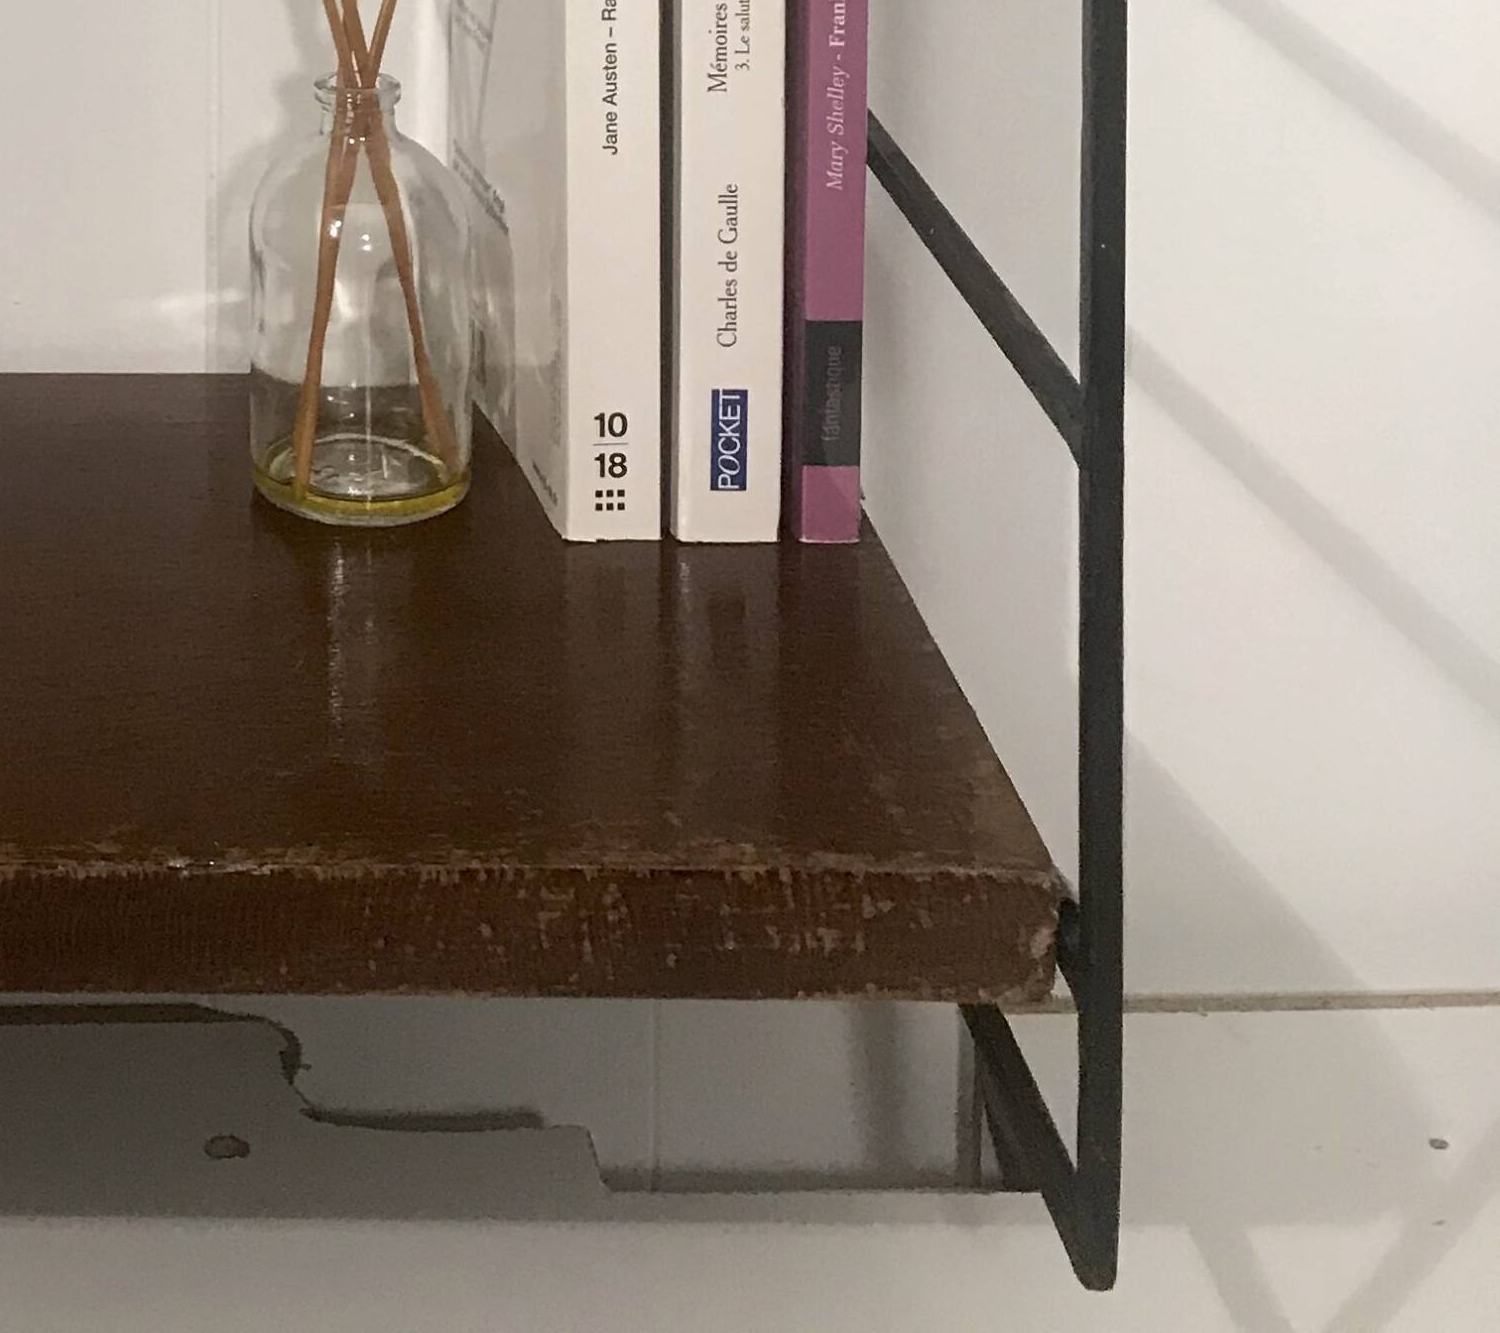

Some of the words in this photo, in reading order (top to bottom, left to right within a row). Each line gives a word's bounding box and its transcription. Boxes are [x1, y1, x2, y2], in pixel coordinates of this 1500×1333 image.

[706, 3, 729, 93] Mémoires
[734, 35, 751, 55] Le
[734, 58, 751, 71] 3.
[601, 42, 619, 107] Austen
[826, 66, 851, 135] Shelley
[601, 111, 619, 156] Jane
[826, 141, 849, 191] Mary
[716, 182, 739, 245] Gaulle
[716, 250, 739, 274] de
[716, 278, 739, 349] Charles
[593, 412, 628, 438] 10
[716, 390, 742, 490] POCKET
[593, 452, 628, 479] 18
